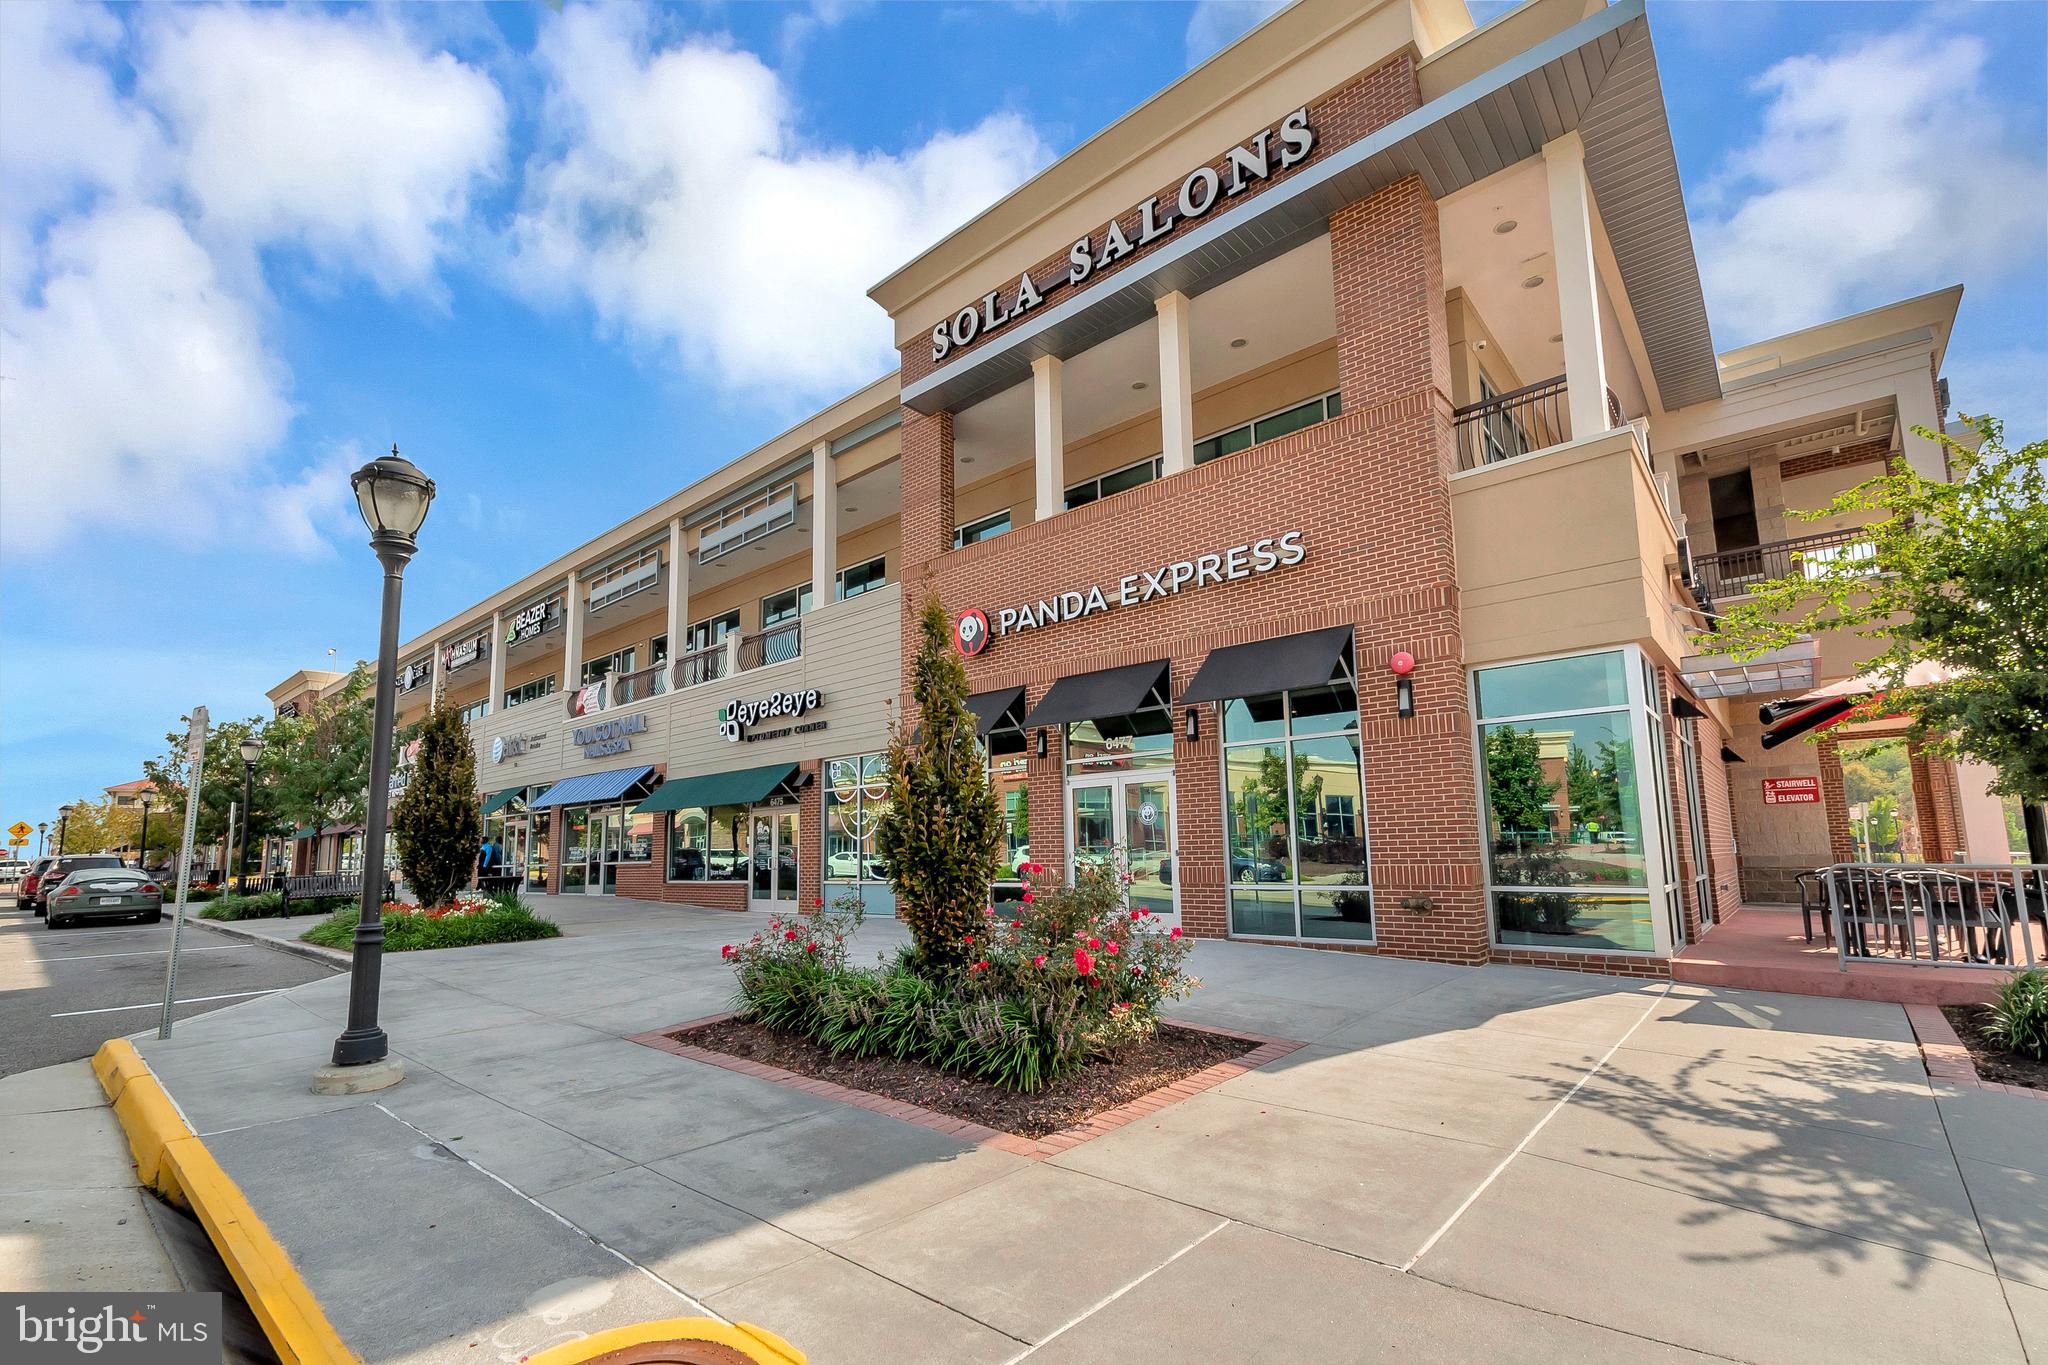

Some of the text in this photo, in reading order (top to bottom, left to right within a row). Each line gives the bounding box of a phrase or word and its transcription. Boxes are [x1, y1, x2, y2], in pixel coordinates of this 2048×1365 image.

[931, 106, 1317, 362] SOLA SALONS
[999, 531, 1306, 635] PANDA EXPRESS
[516, 602, 546, 631] BEAZER
[520, 621, 541, 640] HOMES
[441, 639, 478, 667] MATHNASIUM
[737, 689, 818, 727] eye2eye
[1776, 779, 1816, 788] STAIRWELL
[1778, 793, 1814, 802] ELEVATOR
